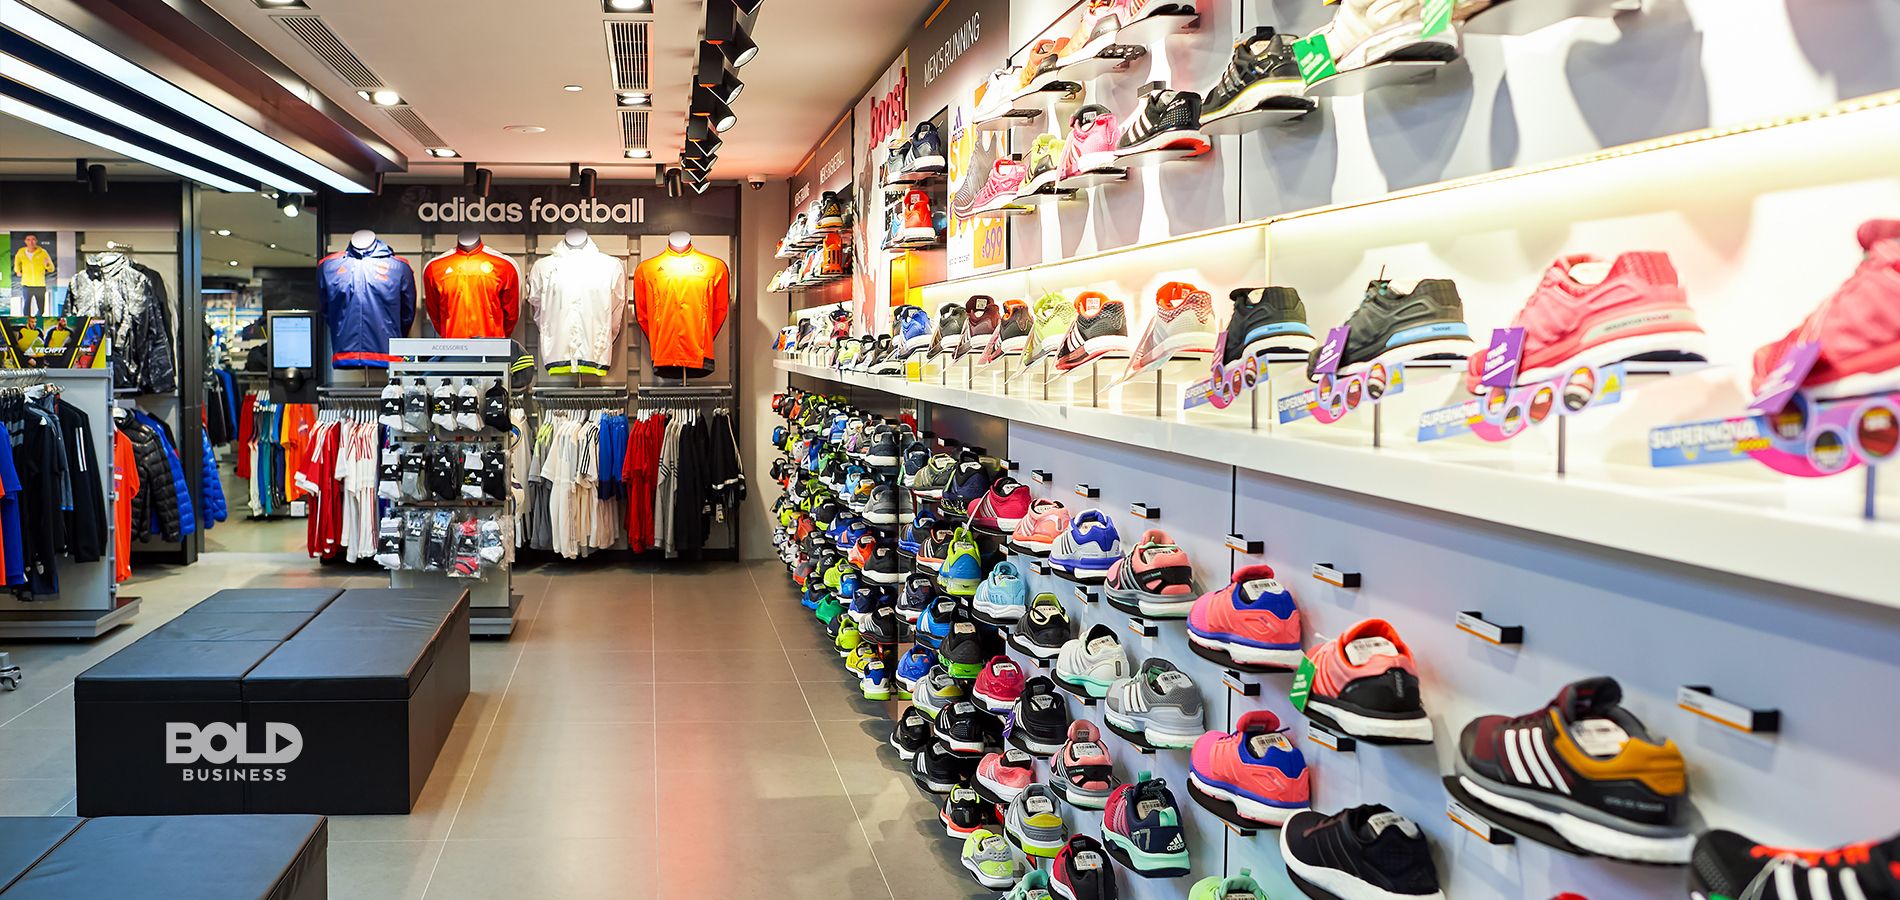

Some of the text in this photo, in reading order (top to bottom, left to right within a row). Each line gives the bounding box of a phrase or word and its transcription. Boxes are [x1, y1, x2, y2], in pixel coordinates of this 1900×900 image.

[944, 11, 980, 69] RUNNING
[870, 66, 907, 150] boost
[418, 197, 645, 223] adidas football
[35, 346, 67, 354] TECHFIT
